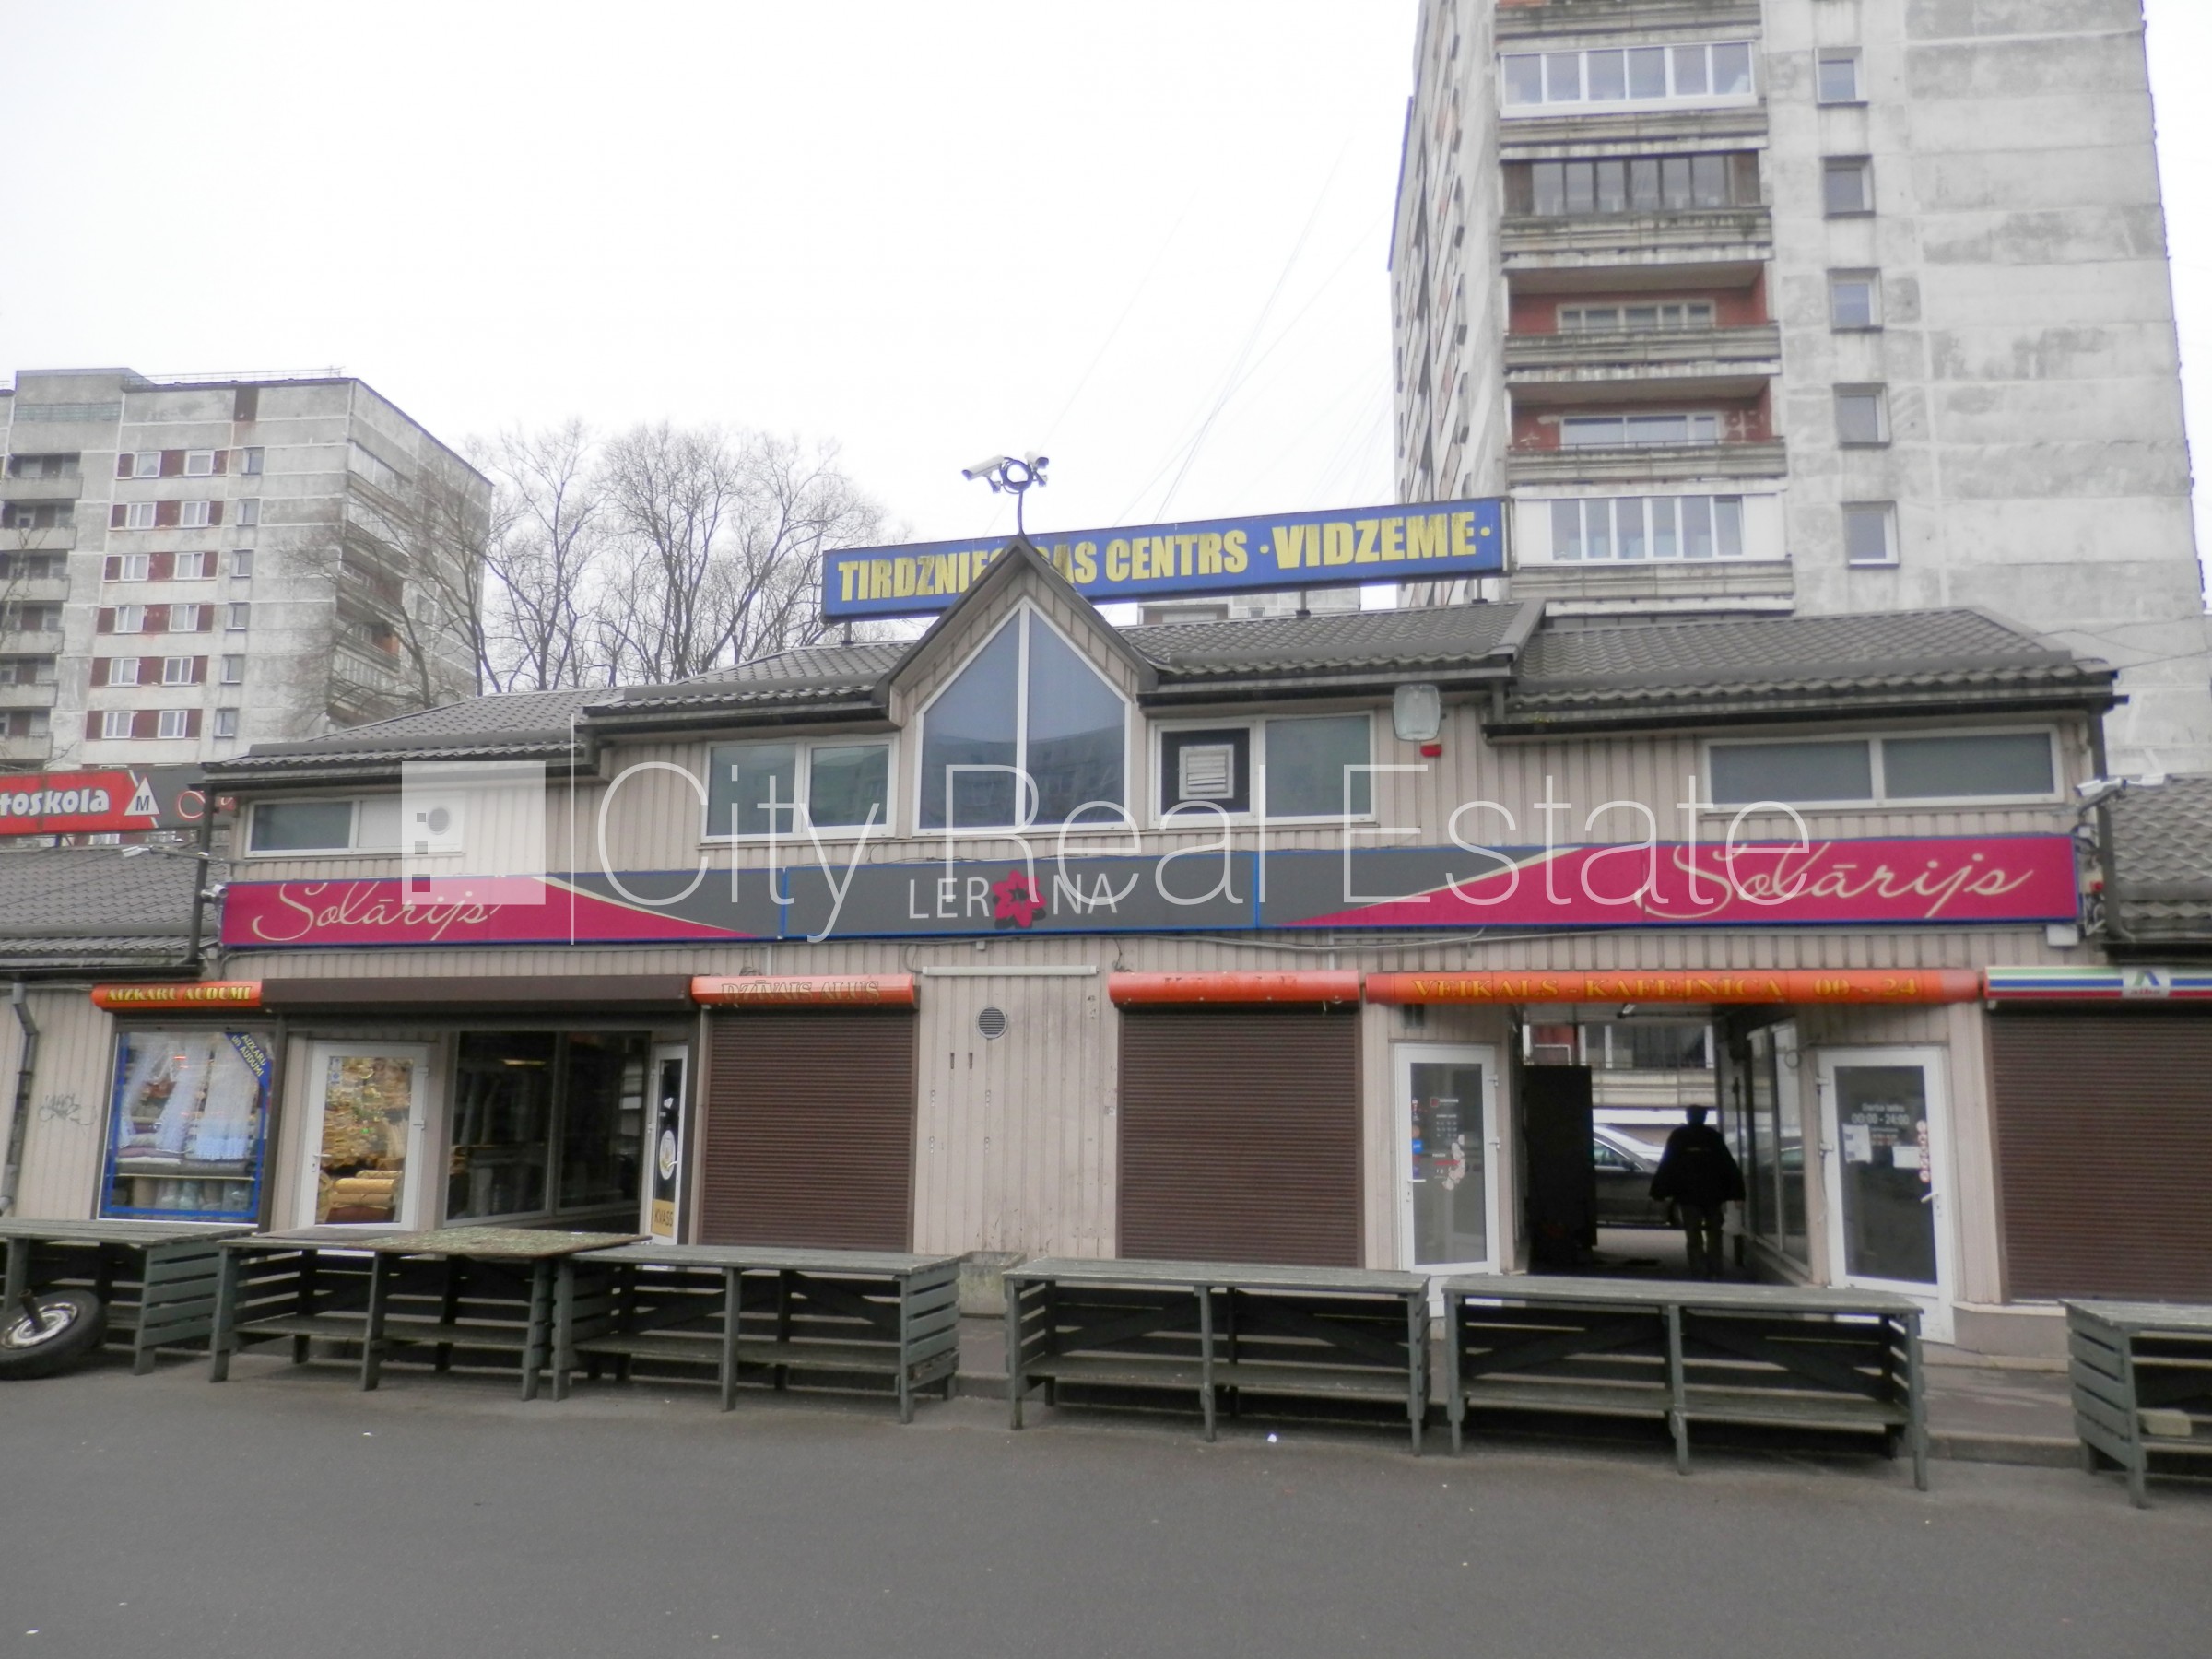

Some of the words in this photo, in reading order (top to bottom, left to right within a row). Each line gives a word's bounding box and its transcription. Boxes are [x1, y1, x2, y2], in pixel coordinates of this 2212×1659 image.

[838, 541, 1098, 602] TIRDZNIEAS
[1105, 530, 1248, 582] CENTRS
[135, 794, 150, 812] M
[820, 980, 880, 1001] ALUS
[1411, 979, 1559, 998] VEIKALS
[1813, 977, 1851, 997] 00
[1881, 977, 1918, 997] 24
[654, 1208, 674, 1228] KVASS
